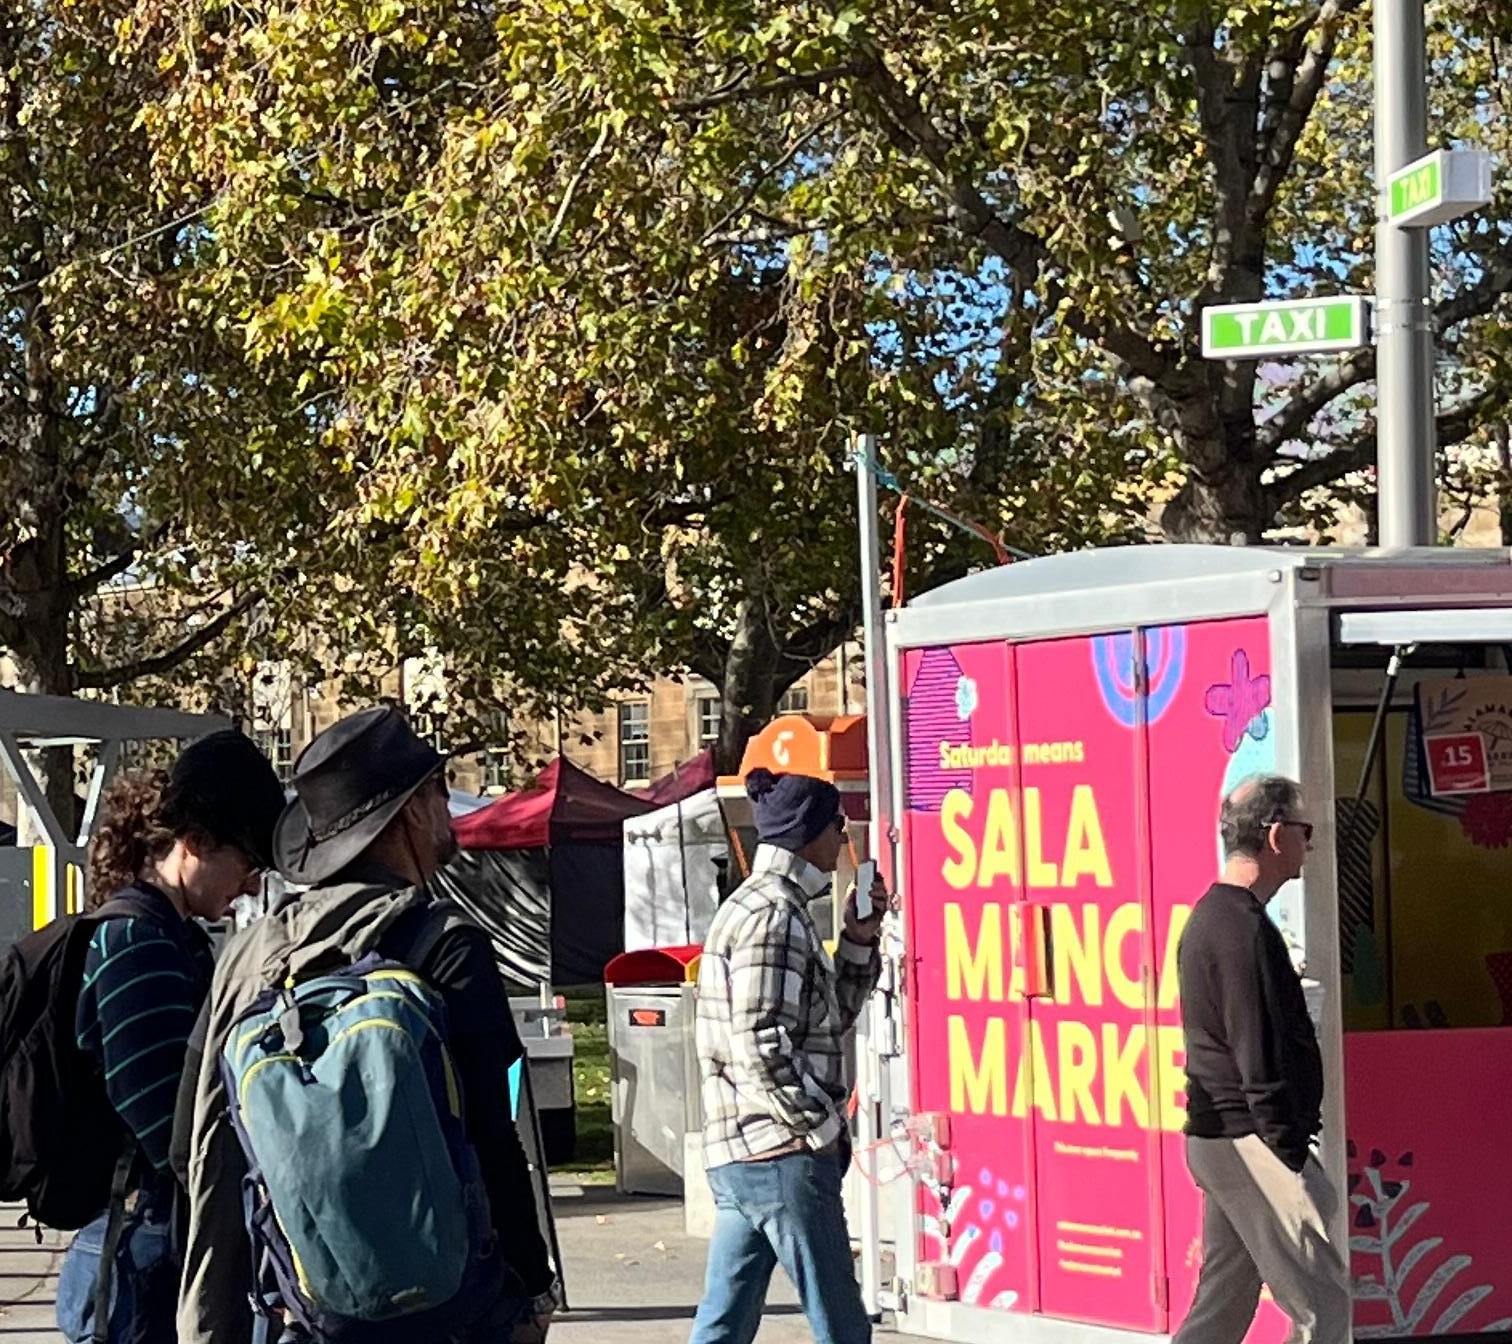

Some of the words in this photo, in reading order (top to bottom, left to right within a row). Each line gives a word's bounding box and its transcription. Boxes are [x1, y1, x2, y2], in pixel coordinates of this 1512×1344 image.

[1398, 164, 1432, 211] TAXI
[1234, 307, 1326, 345] TAXI
[939, 738, 1012, 769] Saturda
[1022, 740, 1084, 765] means
[940, 784, 1115, 889] SALA
[947, 1014, 1190, 1133] MARKE
